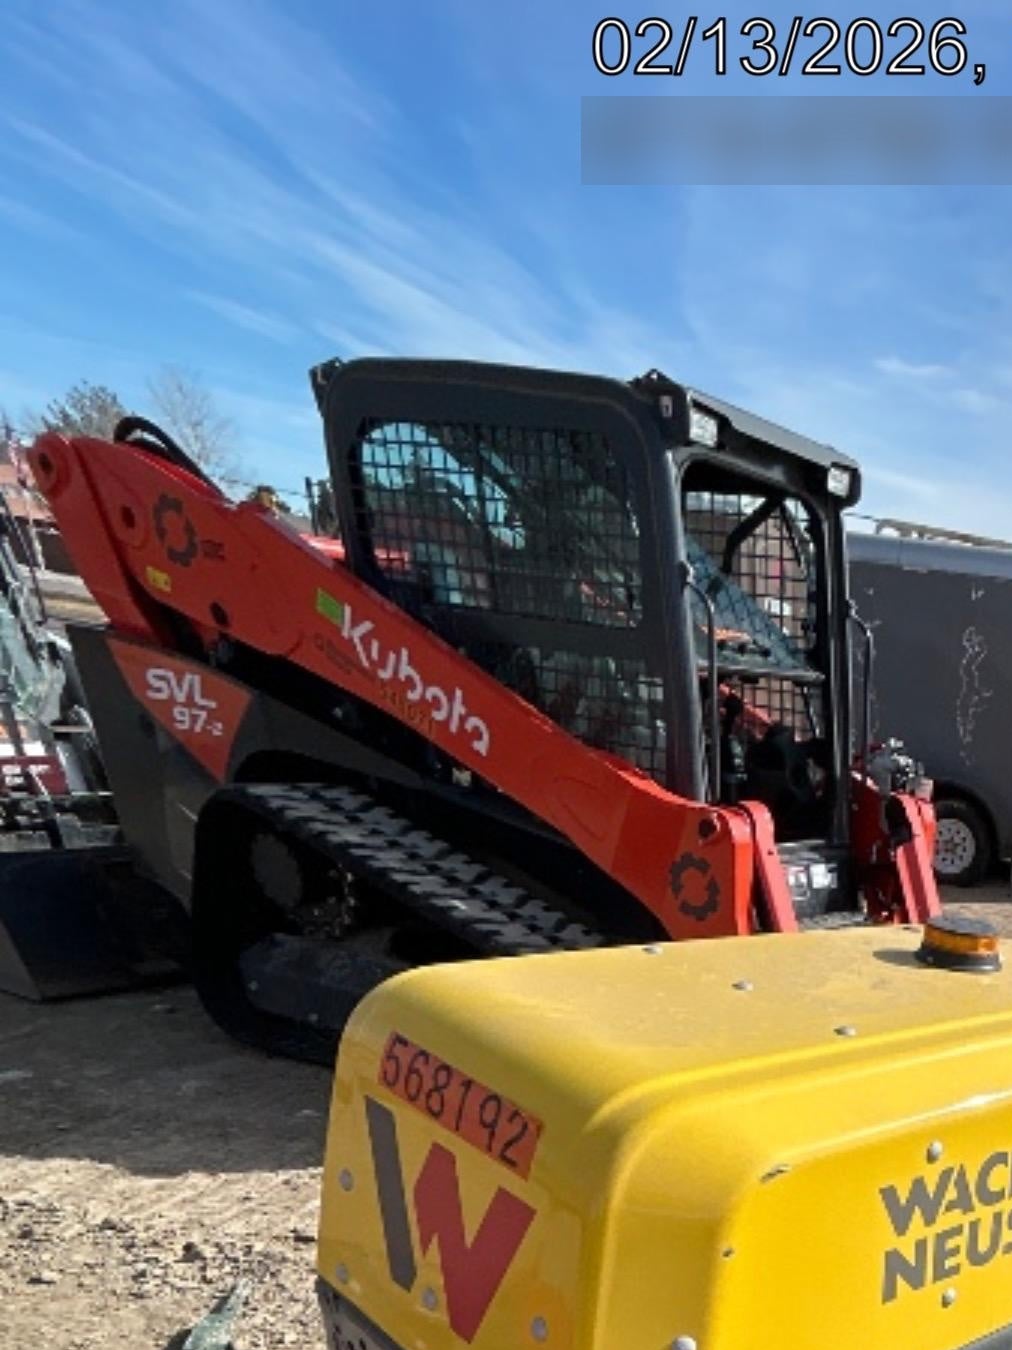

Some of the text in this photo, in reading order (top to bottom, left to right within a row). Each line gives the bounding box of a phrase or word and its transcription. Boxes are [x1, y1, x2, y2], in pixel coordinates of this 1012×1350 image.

[145, 667, 217, 709] SVL
[341, 602, 491, 757] Kubota
[383, 1032, 530, 1168] 568192
